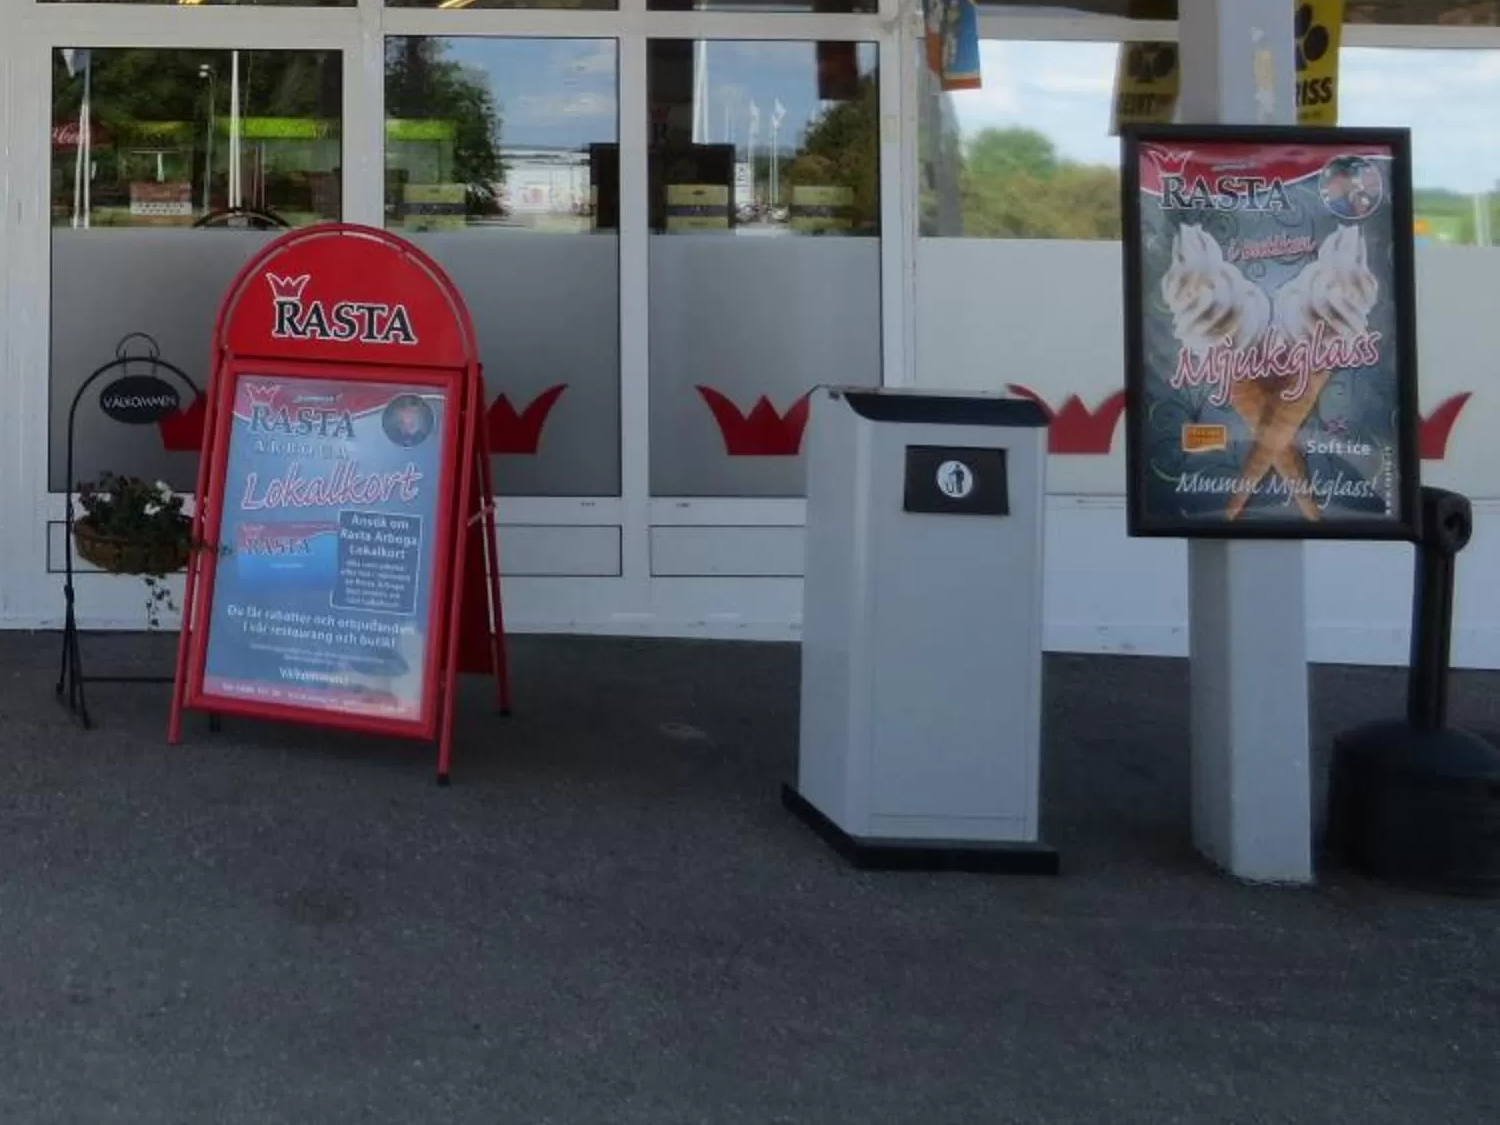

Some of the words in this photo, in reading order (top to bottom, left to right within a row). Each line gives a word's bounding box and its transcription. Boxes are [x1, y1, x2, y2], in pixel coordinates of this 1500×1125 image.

[1159, 173, 1296, 211] RASTA
[272, 299, 419, 345] RASTA
[1170, 321, 1382, 407] Mjukglass
[249, 404, 357, 439] RASTA
[241, 459, 423, 510] Lokalkort
